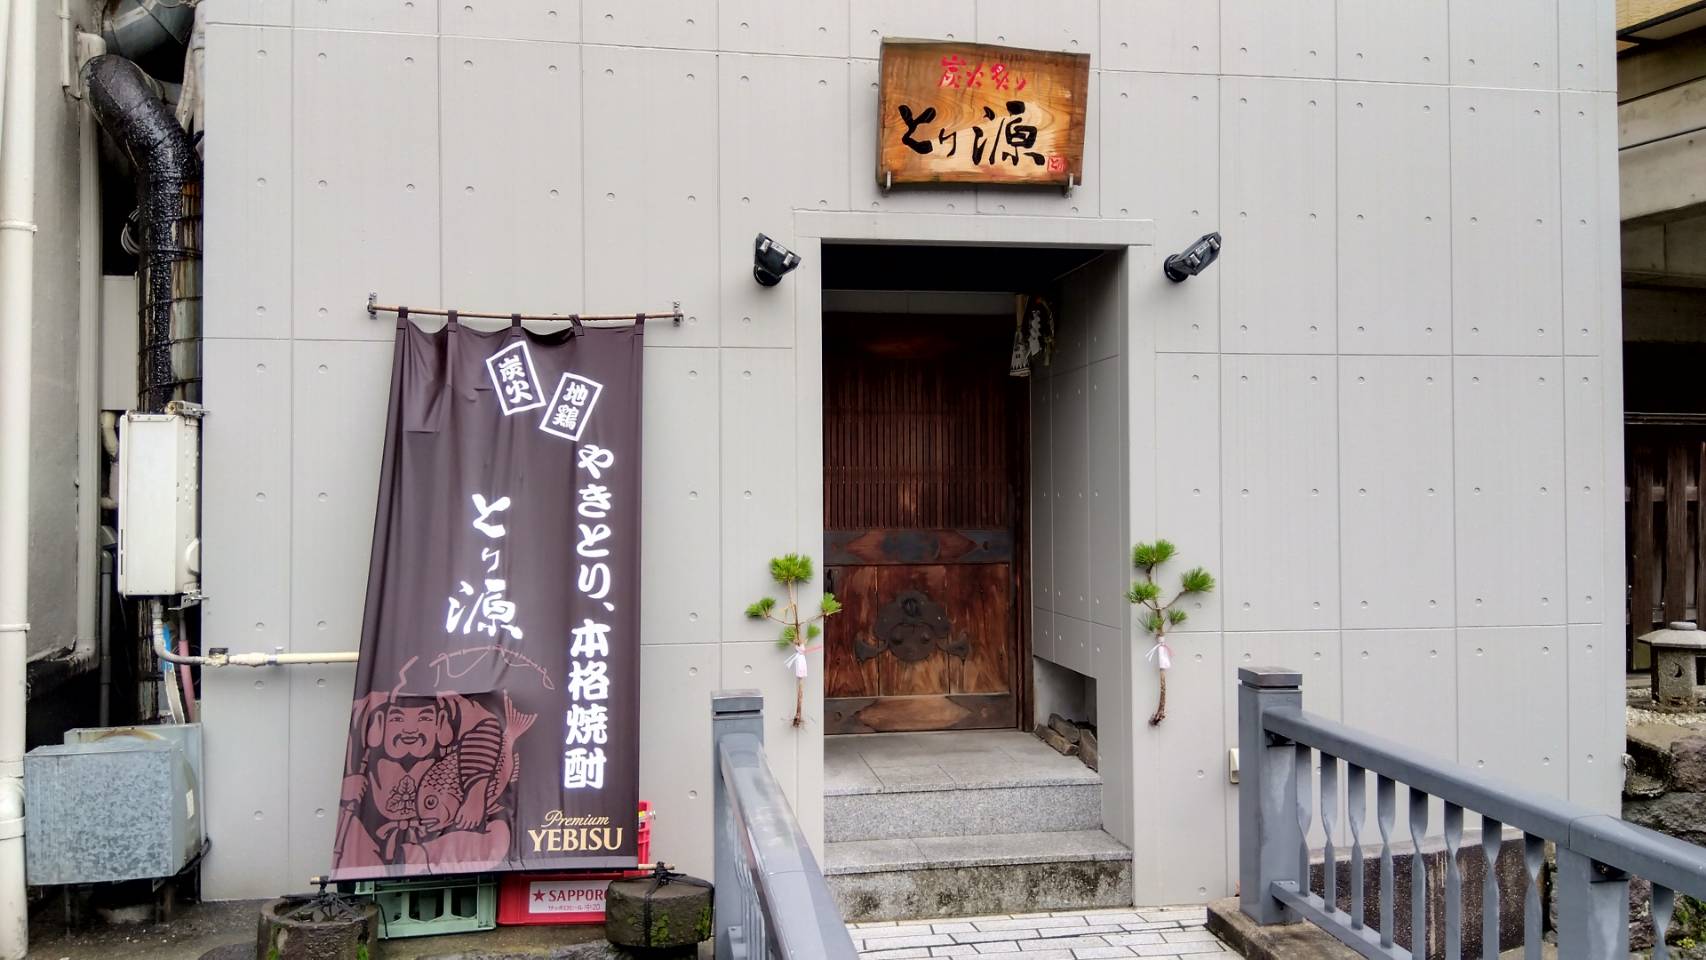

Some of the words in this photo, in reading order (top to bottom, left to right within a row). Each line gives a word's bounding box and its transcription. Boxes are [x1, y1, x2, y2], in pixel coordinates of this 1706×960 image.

[898, 100, 1046, 166] とり源
[498, 354, 534, 404] 炭火
[552, 381, 590, 431] 地鶏
[445, 493, 524, 641] とり源
[527, 827, 624, 852] YEBISU
[540, 809, 610, 828] Premium
